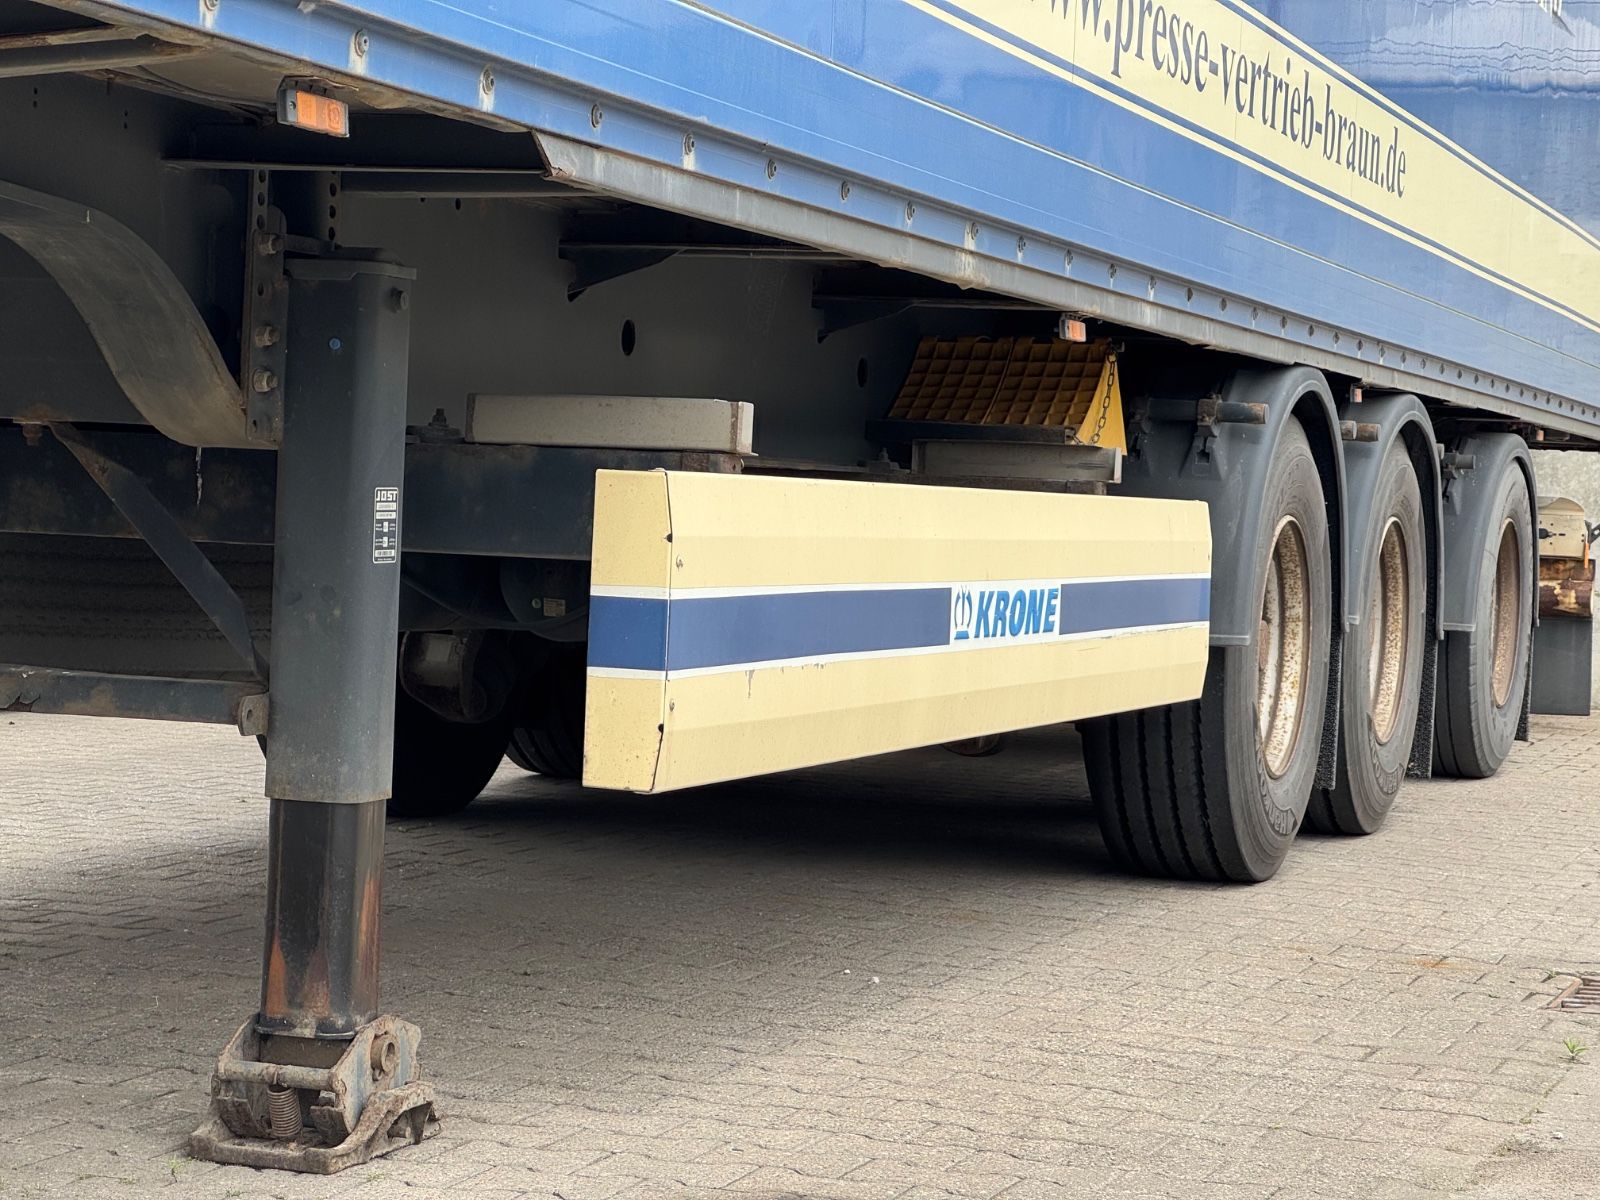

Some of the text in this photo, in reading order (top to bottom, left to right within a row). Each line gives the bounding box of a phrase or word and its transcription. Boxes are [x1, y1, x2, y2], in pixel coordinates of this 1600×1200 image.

[1031, 0, 1406, 198] .presse-vertrieb-braun.de
[376, 490, 398, 502] JOST
[974, 588, 1060, 639] KRONE
